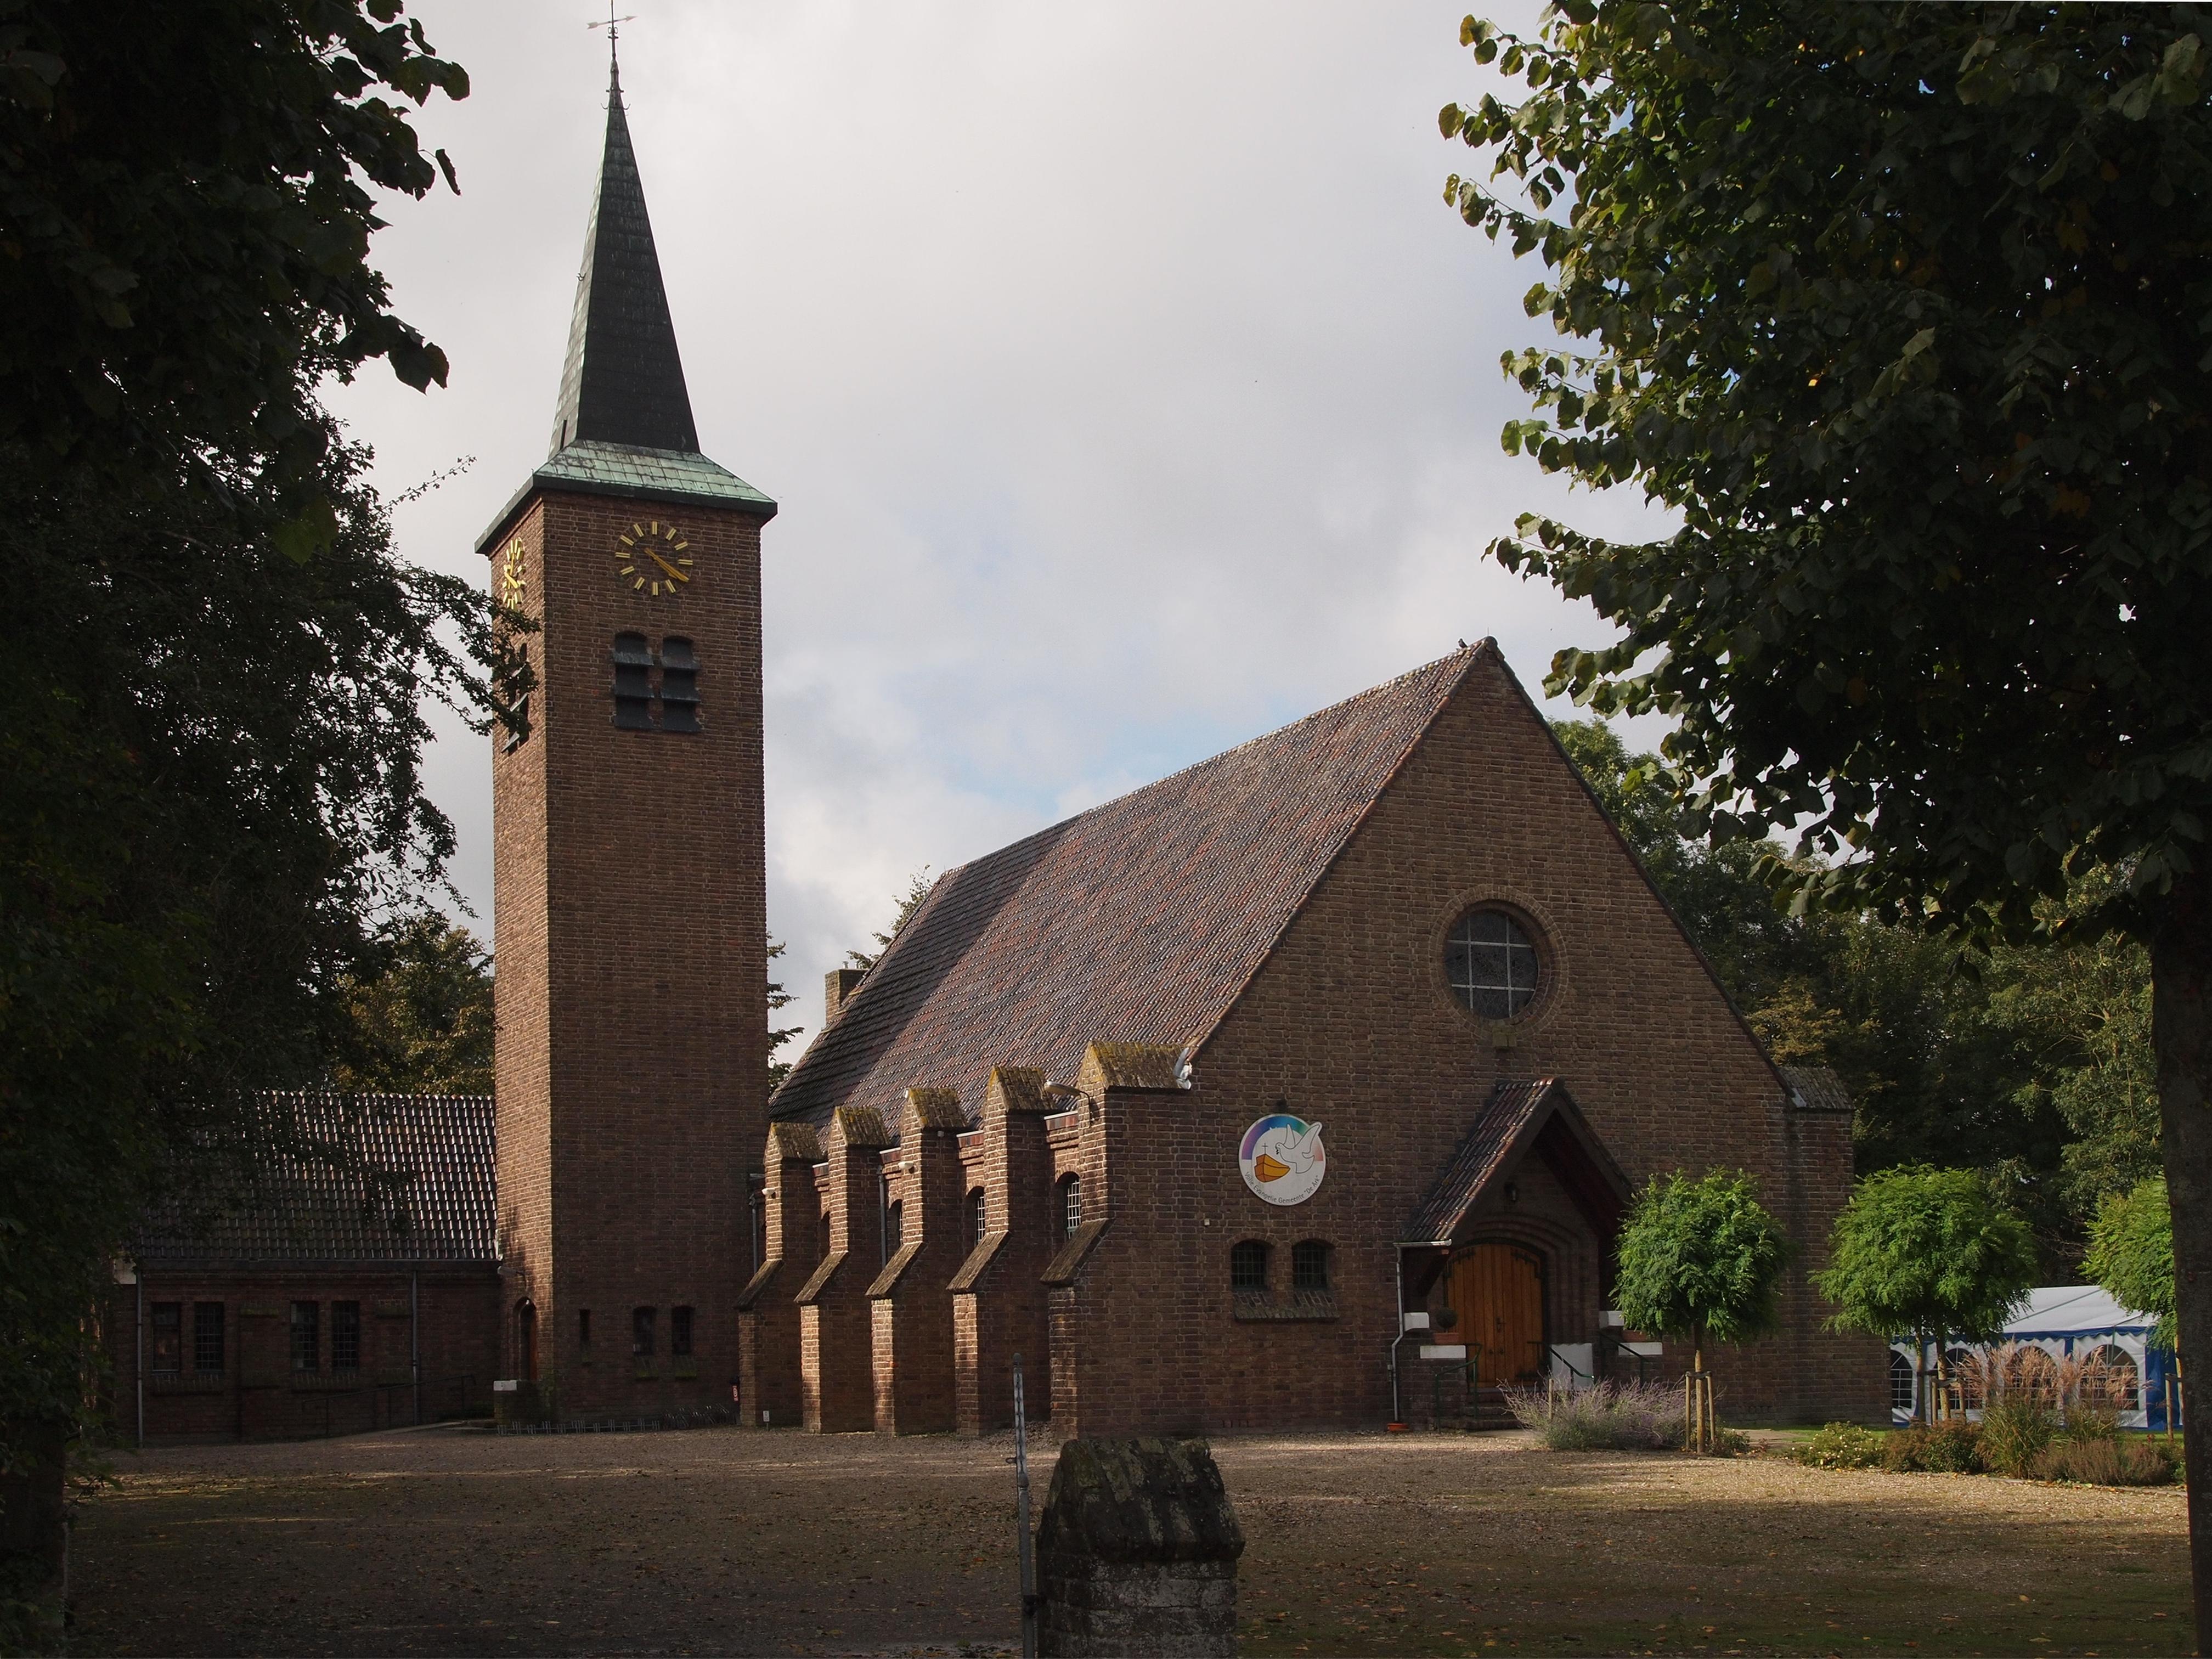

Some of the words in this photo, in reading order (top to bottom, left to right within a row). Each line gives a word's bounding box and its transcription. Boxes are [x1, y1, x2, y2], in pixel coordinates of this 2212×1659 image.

[1245, 1172, 1254, 1186] Volle
[1254, 1185, 1277, 1202] Evangelie
[1278, 1194, 1305, 1204] Gemeente
